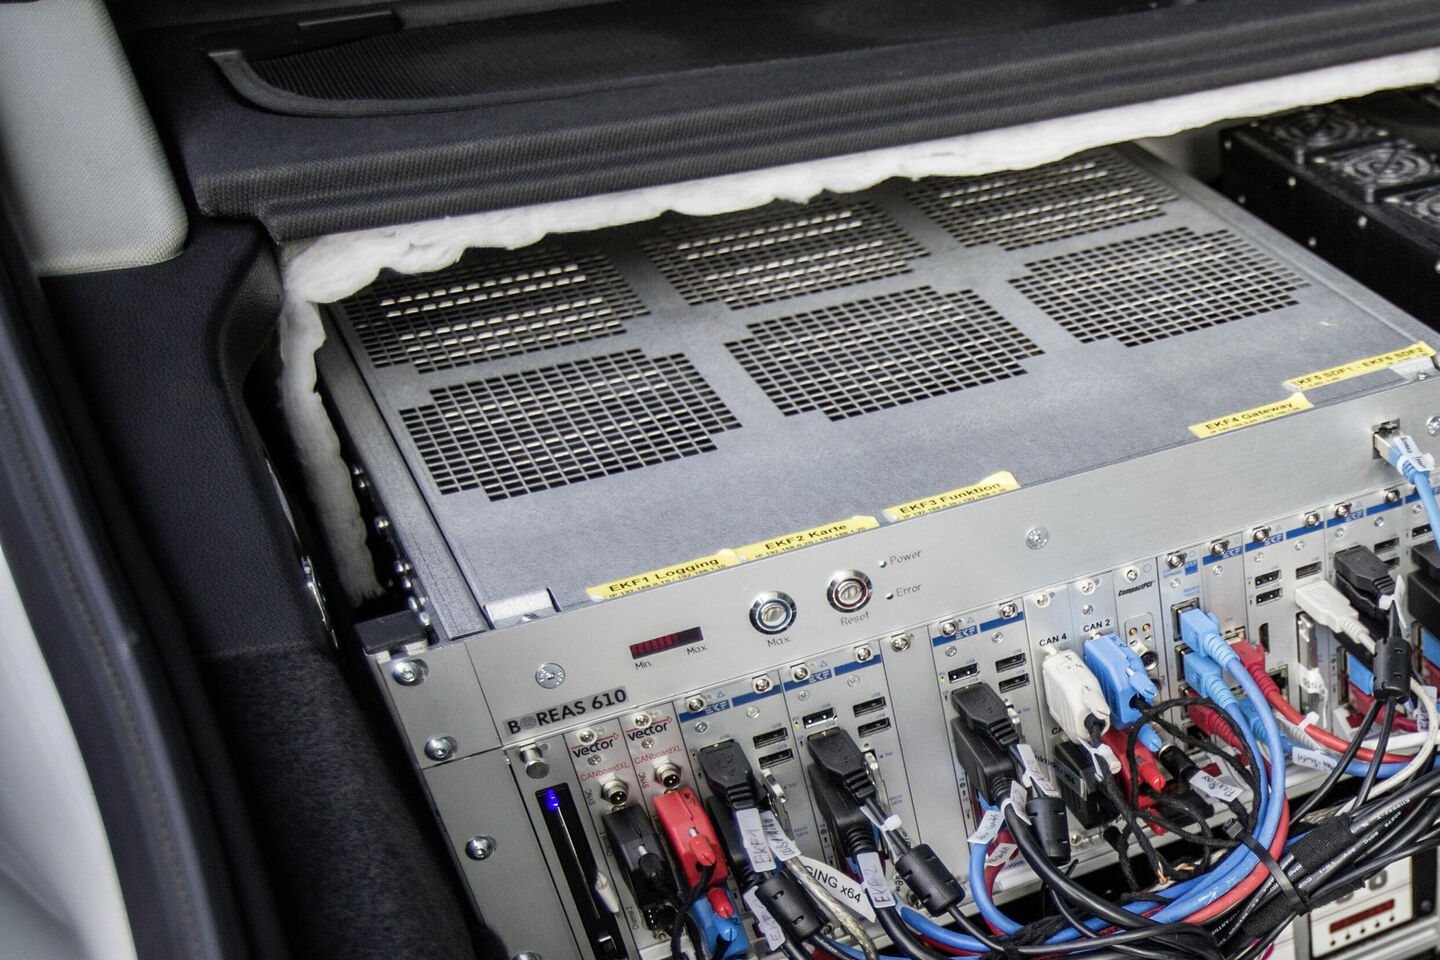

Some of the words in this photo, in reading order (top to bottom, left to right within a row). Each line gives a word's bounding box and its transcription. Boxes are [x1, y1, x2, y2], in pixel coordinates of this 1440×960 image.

[1205, 416, 1239, 430] EKF4
[1242, 402, 1294, 420] Gateway
[900, 500, 938, 515] EKF3
[940, 482, 1001, 503] Funktion
[765, 535, 805, 551] EKF2
[808, 523, 847, 539] Karte
[889, 551, 922, 565] Power
[609, 577, 650, 592] EKF1
[655, 558, 719, 580] Logging
[896, 583, 922, 597] Error
[840, 611, 870, 626] Reset
[1083, 621, 1104, 633] CAN
[1039, 635, 1059, 647] CAN
[592, 688, 627, 710] 610
[627, 722, 668, 741] vector
[572, 737, 615, 758] vector
[634, 745, 683, 765] CANboardXL
[580, 760, 631, 782] CANboardXL
[840, 886, 862, 904] x64
